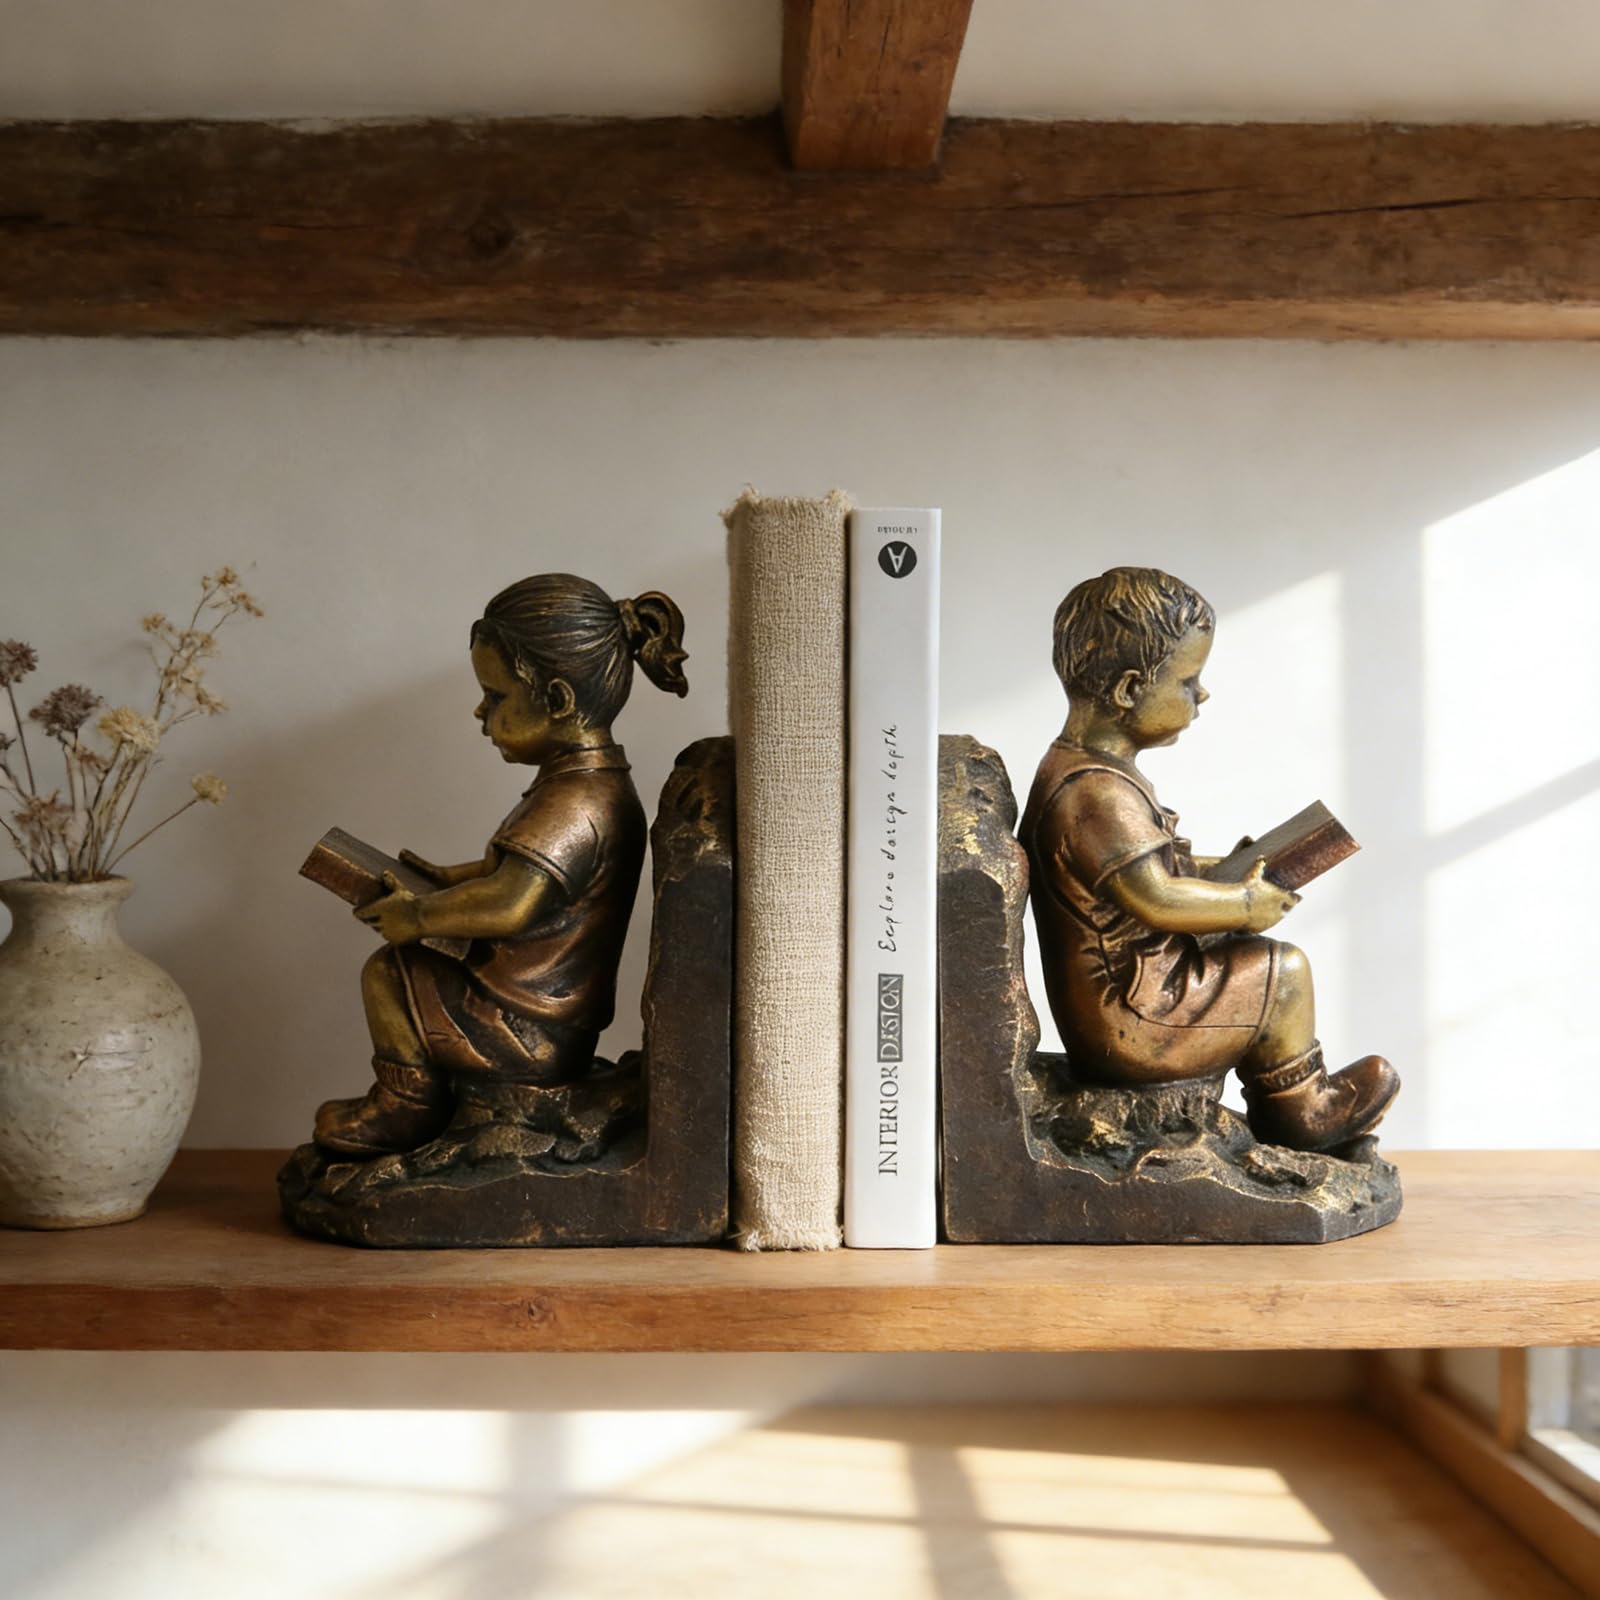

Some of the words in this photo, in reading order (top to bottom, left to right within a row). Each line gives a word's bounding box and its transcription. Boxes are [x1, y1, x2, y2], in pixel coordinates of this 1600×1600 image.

[886, 545, 908, 573] A
[879, 976, 901, 1060] DESIGN
[879, 1064, 900, 1174] INTERIOR
